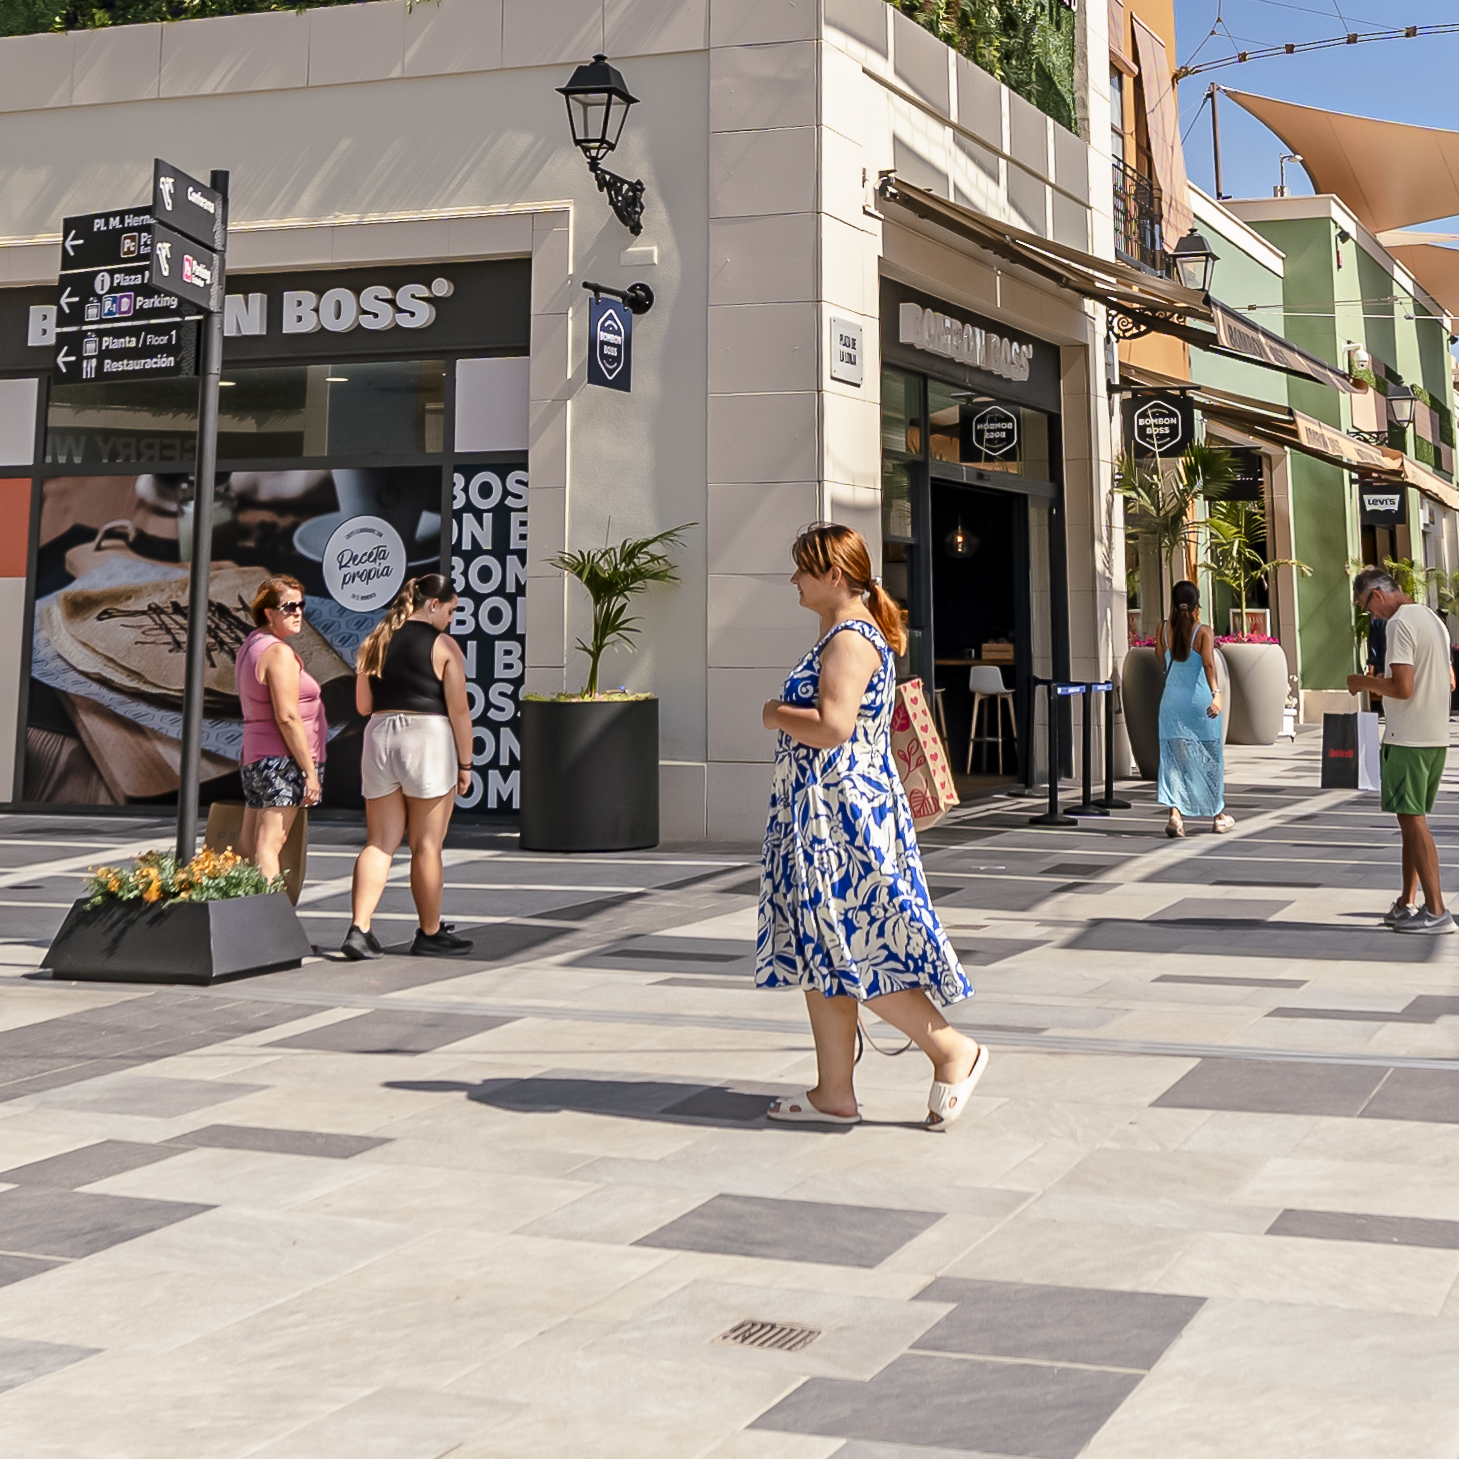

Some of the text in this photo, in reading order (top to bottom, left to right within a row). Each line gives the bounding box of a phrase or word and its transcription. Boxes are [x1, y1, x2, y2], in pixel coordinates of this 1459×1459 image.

[113, 273, 142, 287] Plaza
[136, 293, 179, 310] Parking
[102, 336, 137, 351] Planta
[146, 333, 170, 346] Floor
[103, 354, 176, 374] Restauración
[1138, 417, 1177, 426] BOMBON
[1146, 426, 1170, 435] BOSS
[336, 544, 391, 571] Receta
[340, 562, 394, 590] propia
